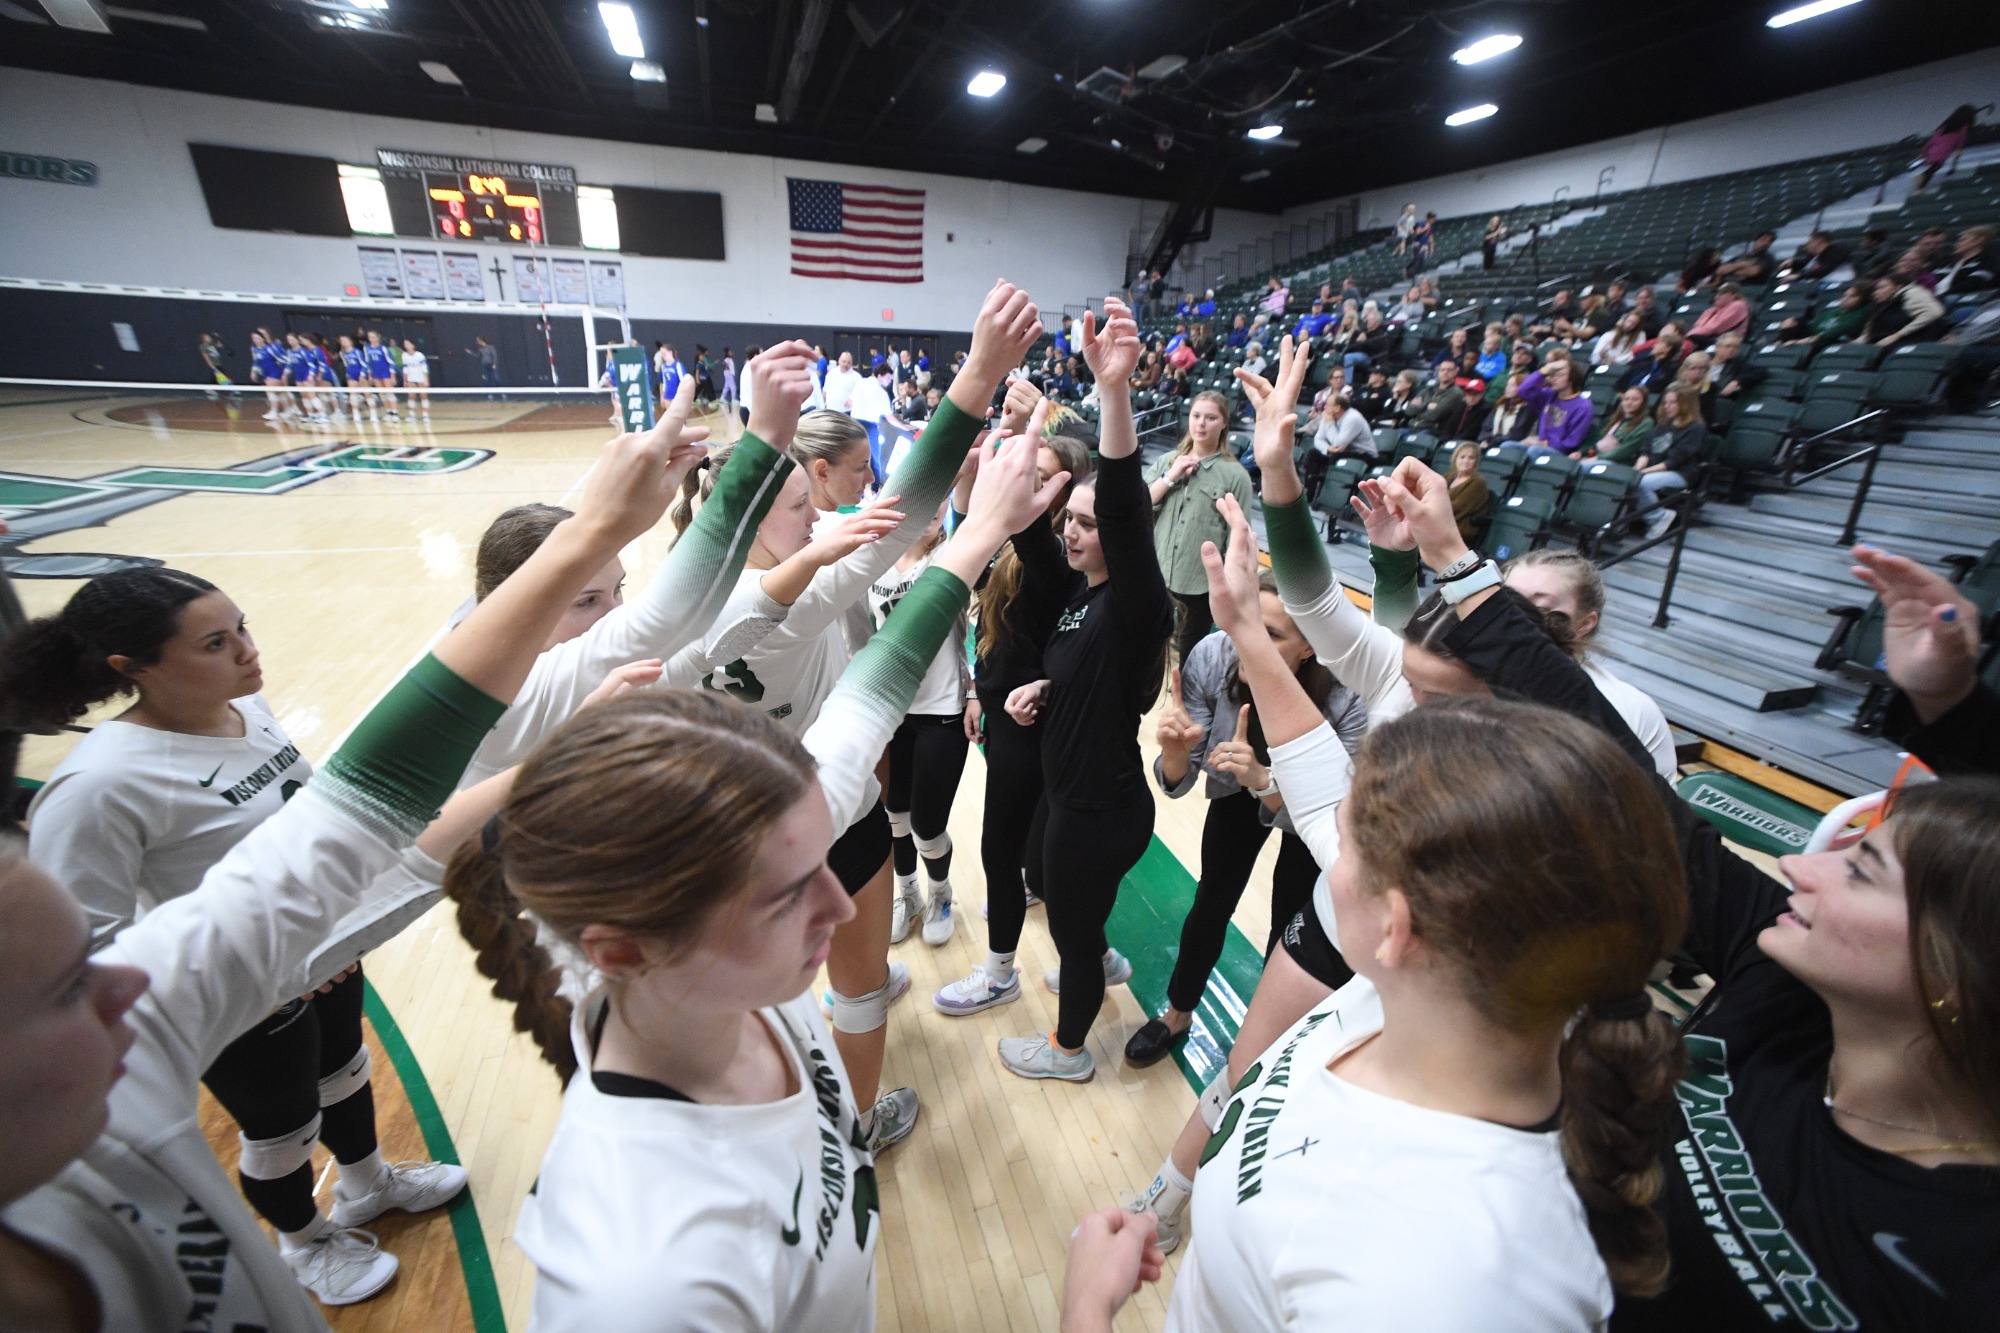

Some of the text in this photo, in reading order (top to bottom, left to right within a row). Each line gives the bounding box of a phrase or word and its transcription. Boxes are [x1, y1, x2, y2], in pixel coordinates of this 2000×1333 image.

[377, 149, 574, 182] WISCONSIN LUTHERAN COLLEGE
[219, 763, 278, 806] WISCONSIN
[1691, 785, 1807, 846] WARRIORS
[1236, 1096, 1286, 1206] LUTHERAN
[1674, 1034, 1860, 1331] WARRIORS
[1674, 1138, 1788, 1321] VOLLEYBALL
